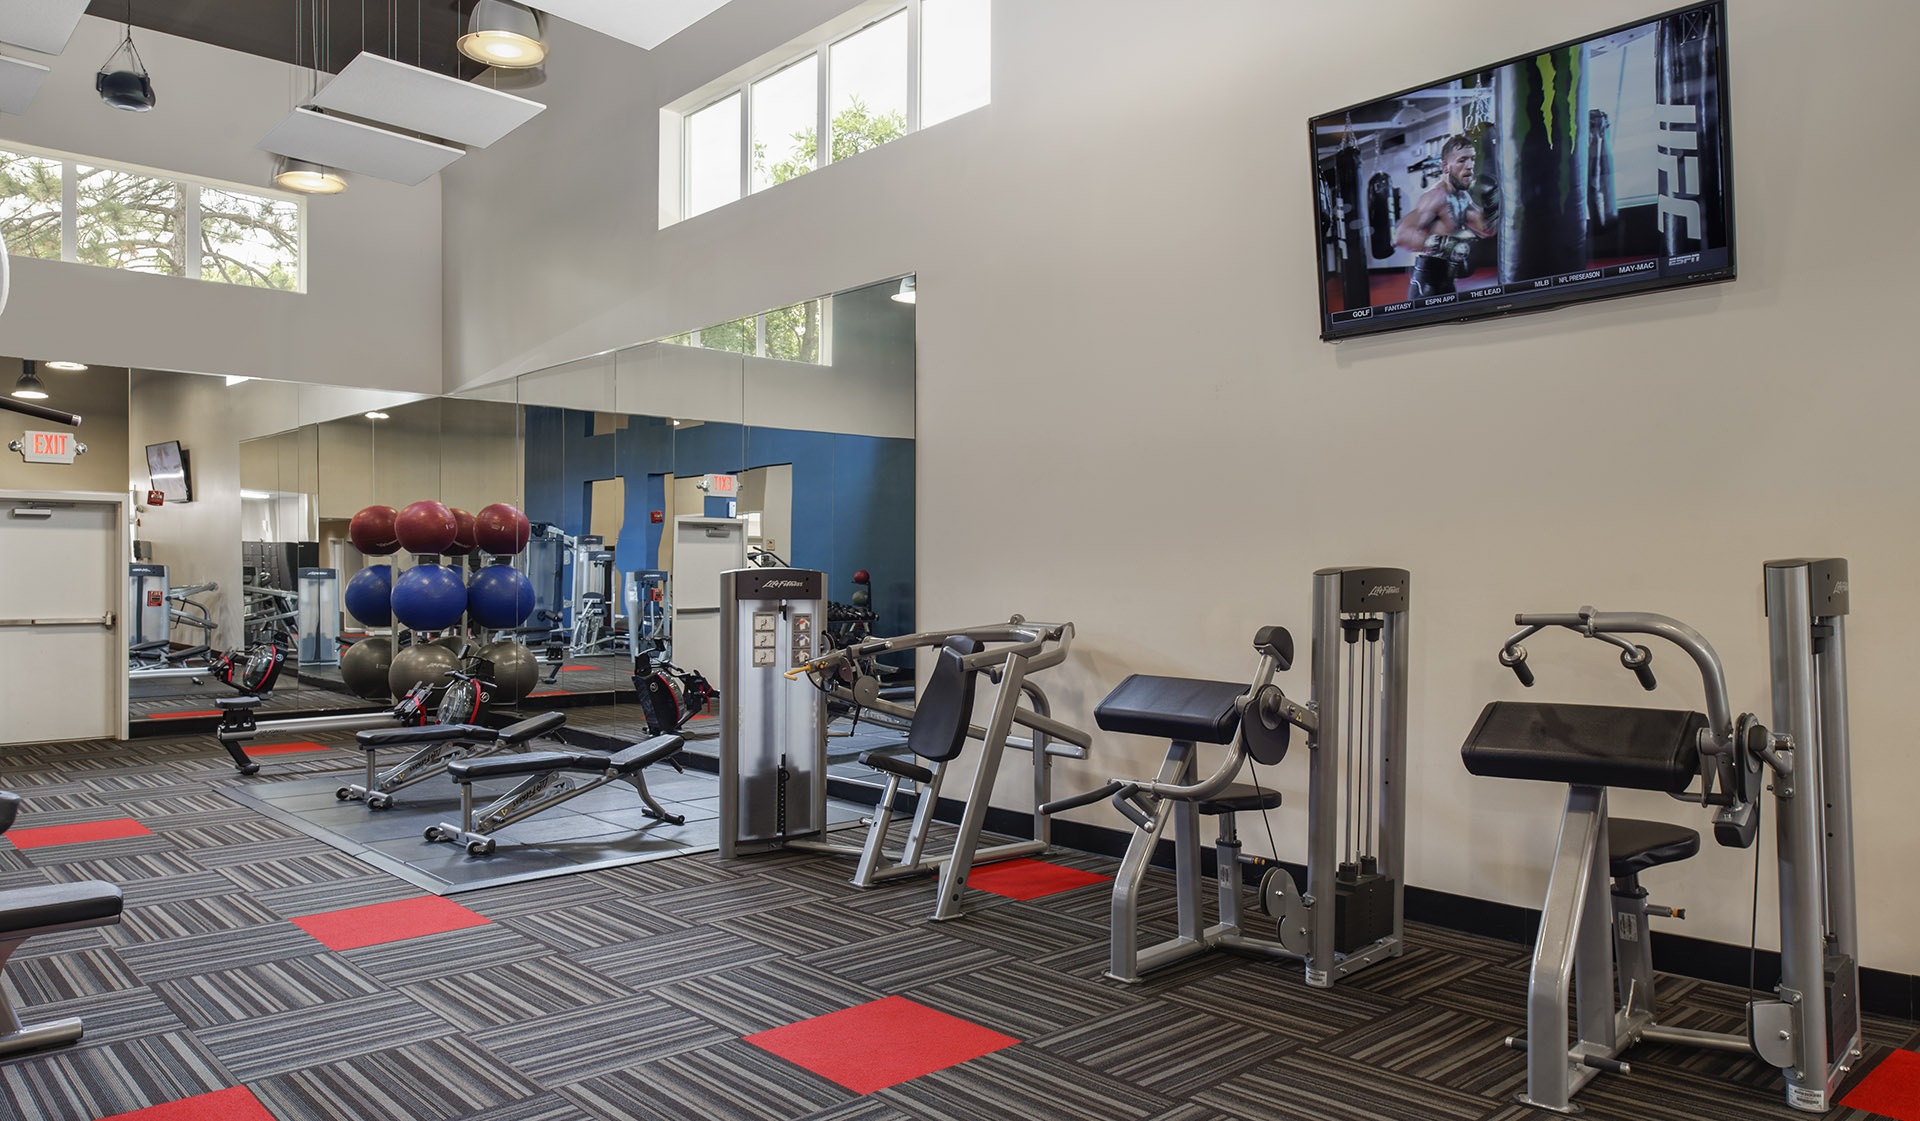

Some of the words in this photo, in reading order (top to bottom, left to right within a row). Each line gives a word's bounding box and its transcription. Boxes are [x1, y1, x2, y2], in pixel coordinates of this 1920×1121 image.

[1654, 104, 1702, 240] UFC
[1668, 253, 1701, 266] ESPN
[1618, 261, 1655, 274] MAY-MAC
[1534, 278, 1550, 288] MLB
[1558, 275, 1569, 284] NFL
[1569, 270, 1600, 282] PRESEASON
[1470, 290, 1484, 298] THE
[1484, 287, 1502, 296] LEAD
[1425, 298, 1442, 306] ESPN
[1442, 295, 1455, 304] APP
[1352, 308, 1371, 318] GOLF
[1384, 302, 1412, 313] FANTASY
[33, 433, 68, 455] EXIT
